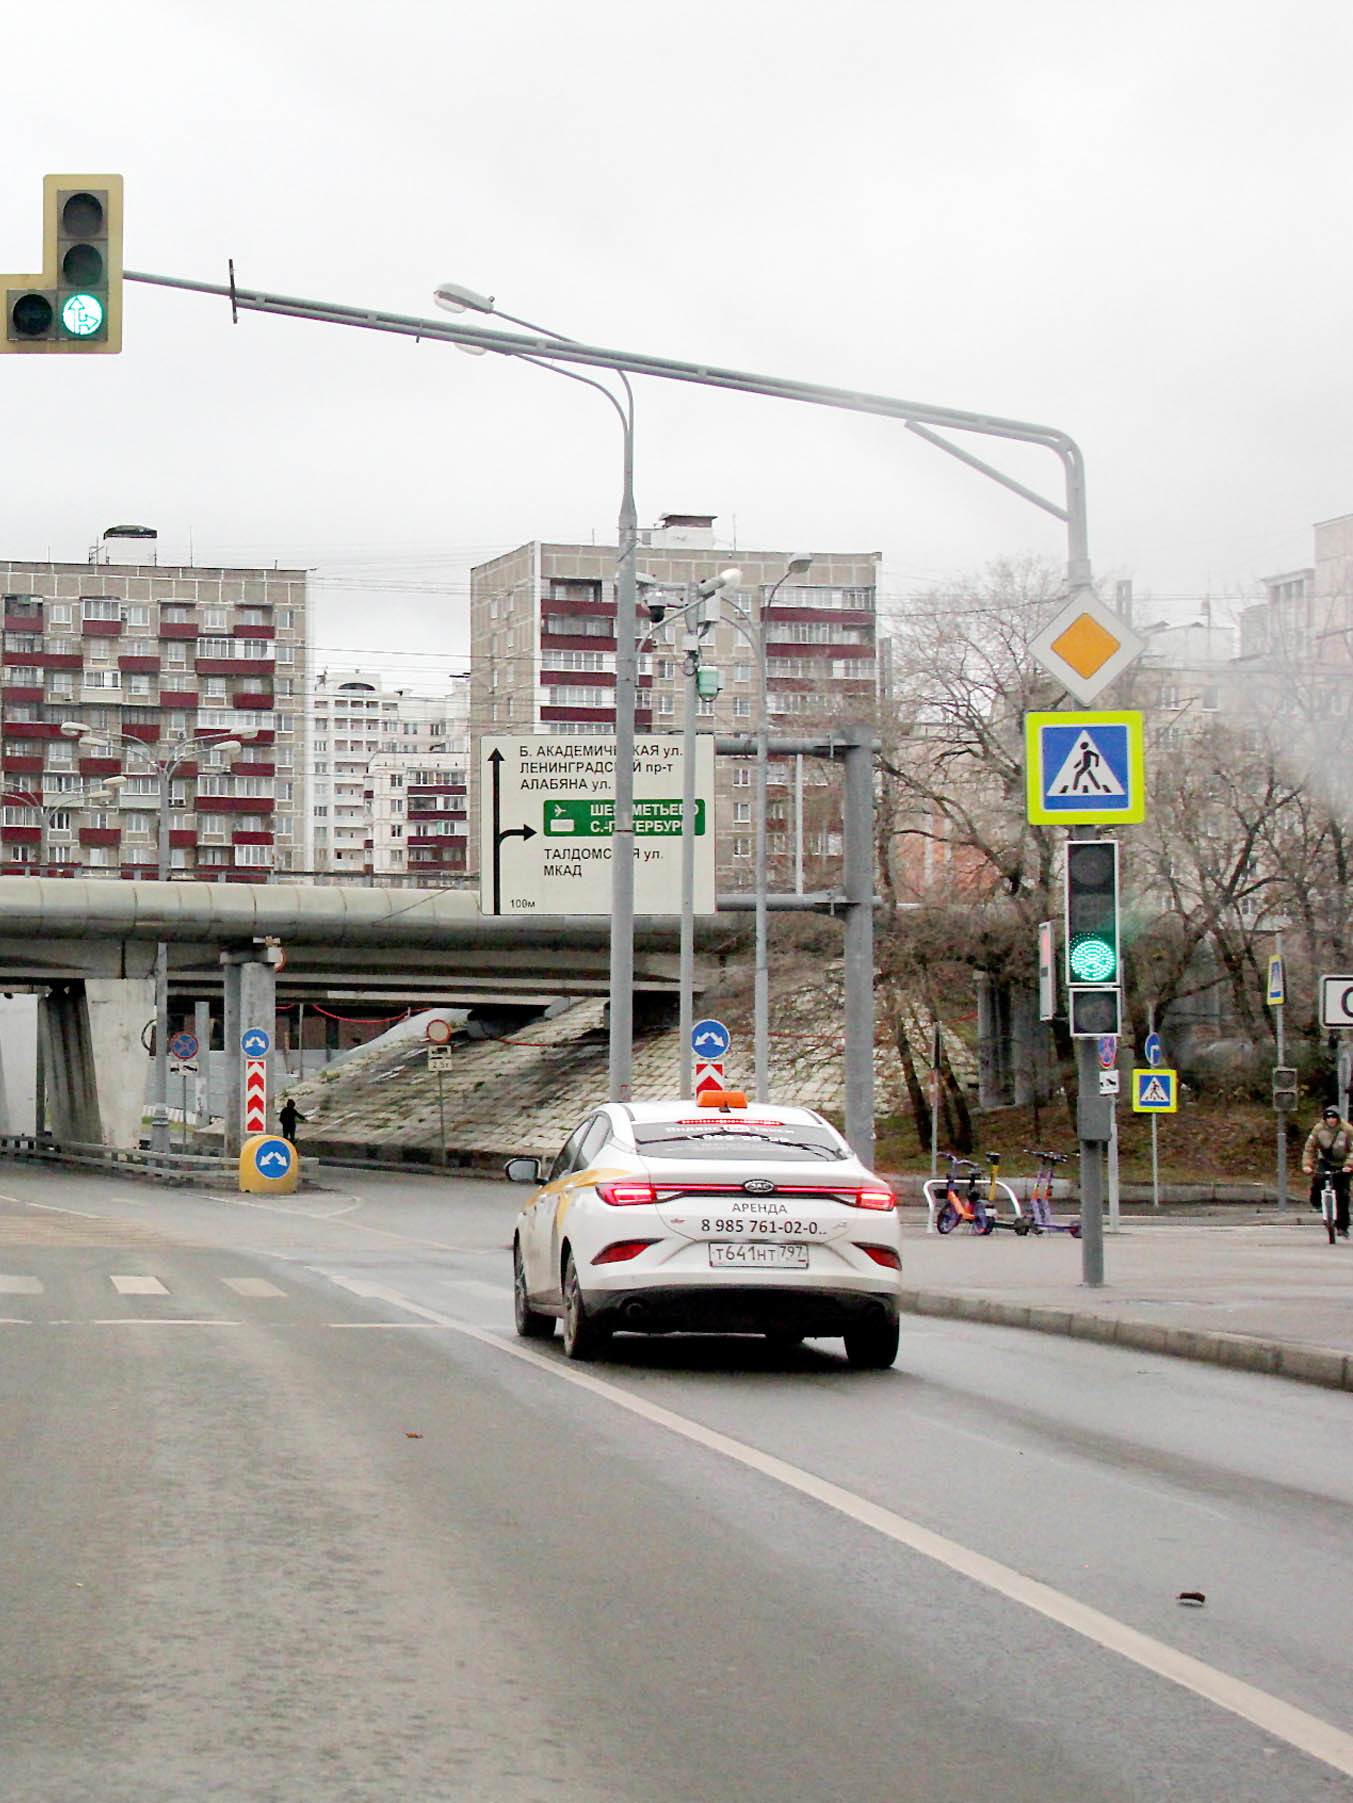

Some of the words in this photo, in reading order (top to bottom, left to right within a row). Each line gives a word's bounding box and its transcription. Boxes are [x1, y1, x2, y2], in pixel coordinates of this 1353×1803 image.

[520, 745, 532, 757] Б.
[537, 744, 660, 758] АКАДЕМИЧКАЯ
[663, 747, 683, 759] ул.
[520, 759, 641, 774] ЛЕНИНГРАДСЙ
[646, 763, 674, 775] пр-т
[520, 778, 588, 791] АЛАБЯНА
[592, 780, 612, 792] ул.
[544, 848, 640, 861] ТАЛДОМСЯ
[644, 850, 664, 862] ул.
[544, 864, 582, 877] МКАД
[511, 899, 536, 909] 100м
[732, 1203, 788, 1215] АРЕНДА
[701, 1219, 711, 1232] 8
[715, 1219, 744, 1233] 985
[780, 1246, 803, 1257] 797
